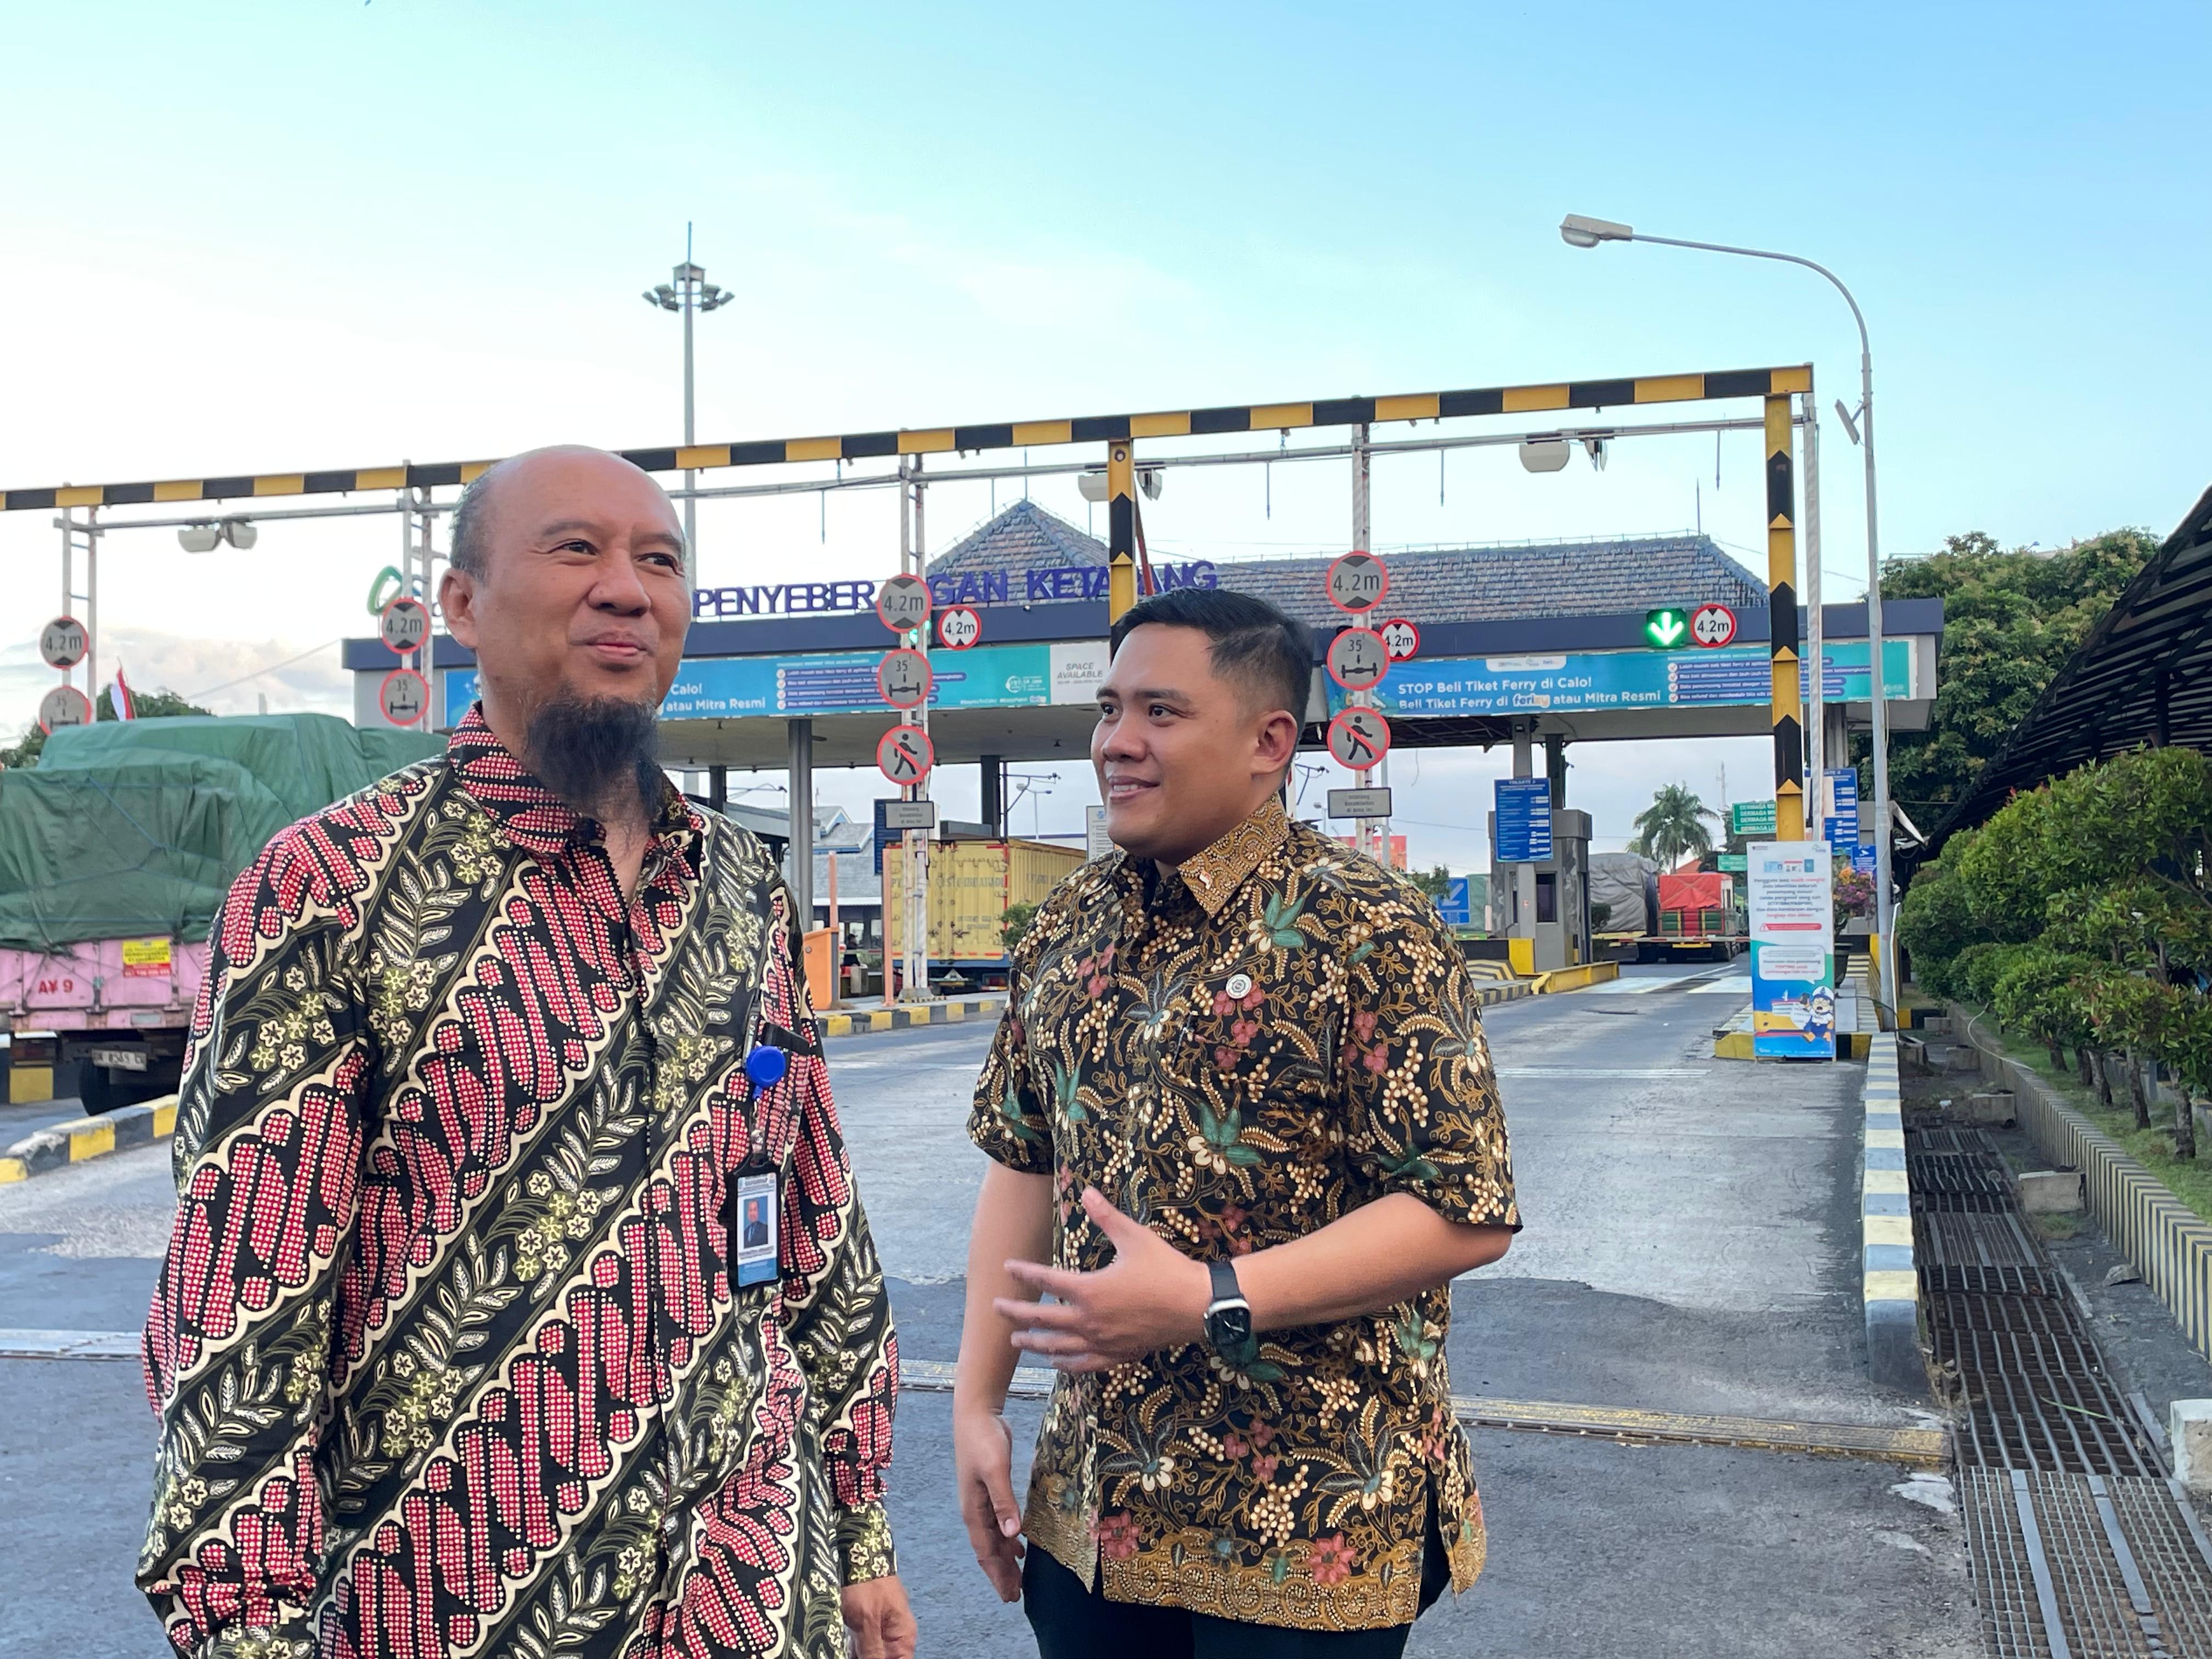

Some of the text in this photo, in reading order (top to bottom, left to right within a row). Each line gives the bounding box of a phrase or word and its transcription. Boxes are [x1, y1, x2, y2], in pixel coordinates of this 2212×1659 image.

[1027, 561, 1217, 601] KETAANG
[1333, 574, 1379, 591] 4.2m
[884, 594, 924, 612] 4.2m
[386, 618, 422, 634] 4.2m
[945, 622, 975, 636] 4.2m
[1697, 620, 1729, 633] 4.2m
[46, 635, 82, 651] 4.2m
[1384, 634, 1413, 647] 4.2m
[1057, 670, 1103, 679] AVAILABLE
[1066, 662, 1094, 671] SPACE
[1398, 682, 1434, 695] STOP
[1437, 681, 1462, 693] Beli
[1465, 680, 1498, 692] Tiket
[1502, 679, 1537, 692] Ferry
[1541, 678, 1553, 689] di
[666, 701, 693, 712] atau
[696, 698, 726, 710] Mitra
[729, 696, 766, 709] Resmi
[1399, 698, 1422, 710] Beli
[1425, 698, 1457, 709] Tiket
[1459, 697, 1493, 709] Ferry
[1496, 695, 1509, 707] di
[1553, 693, 1582, 705] atau
[1585, 692, 1618, 704] Mitra
[1621, 690, 1661, 702] Resmi
[63, 979, 72, 993] 9
